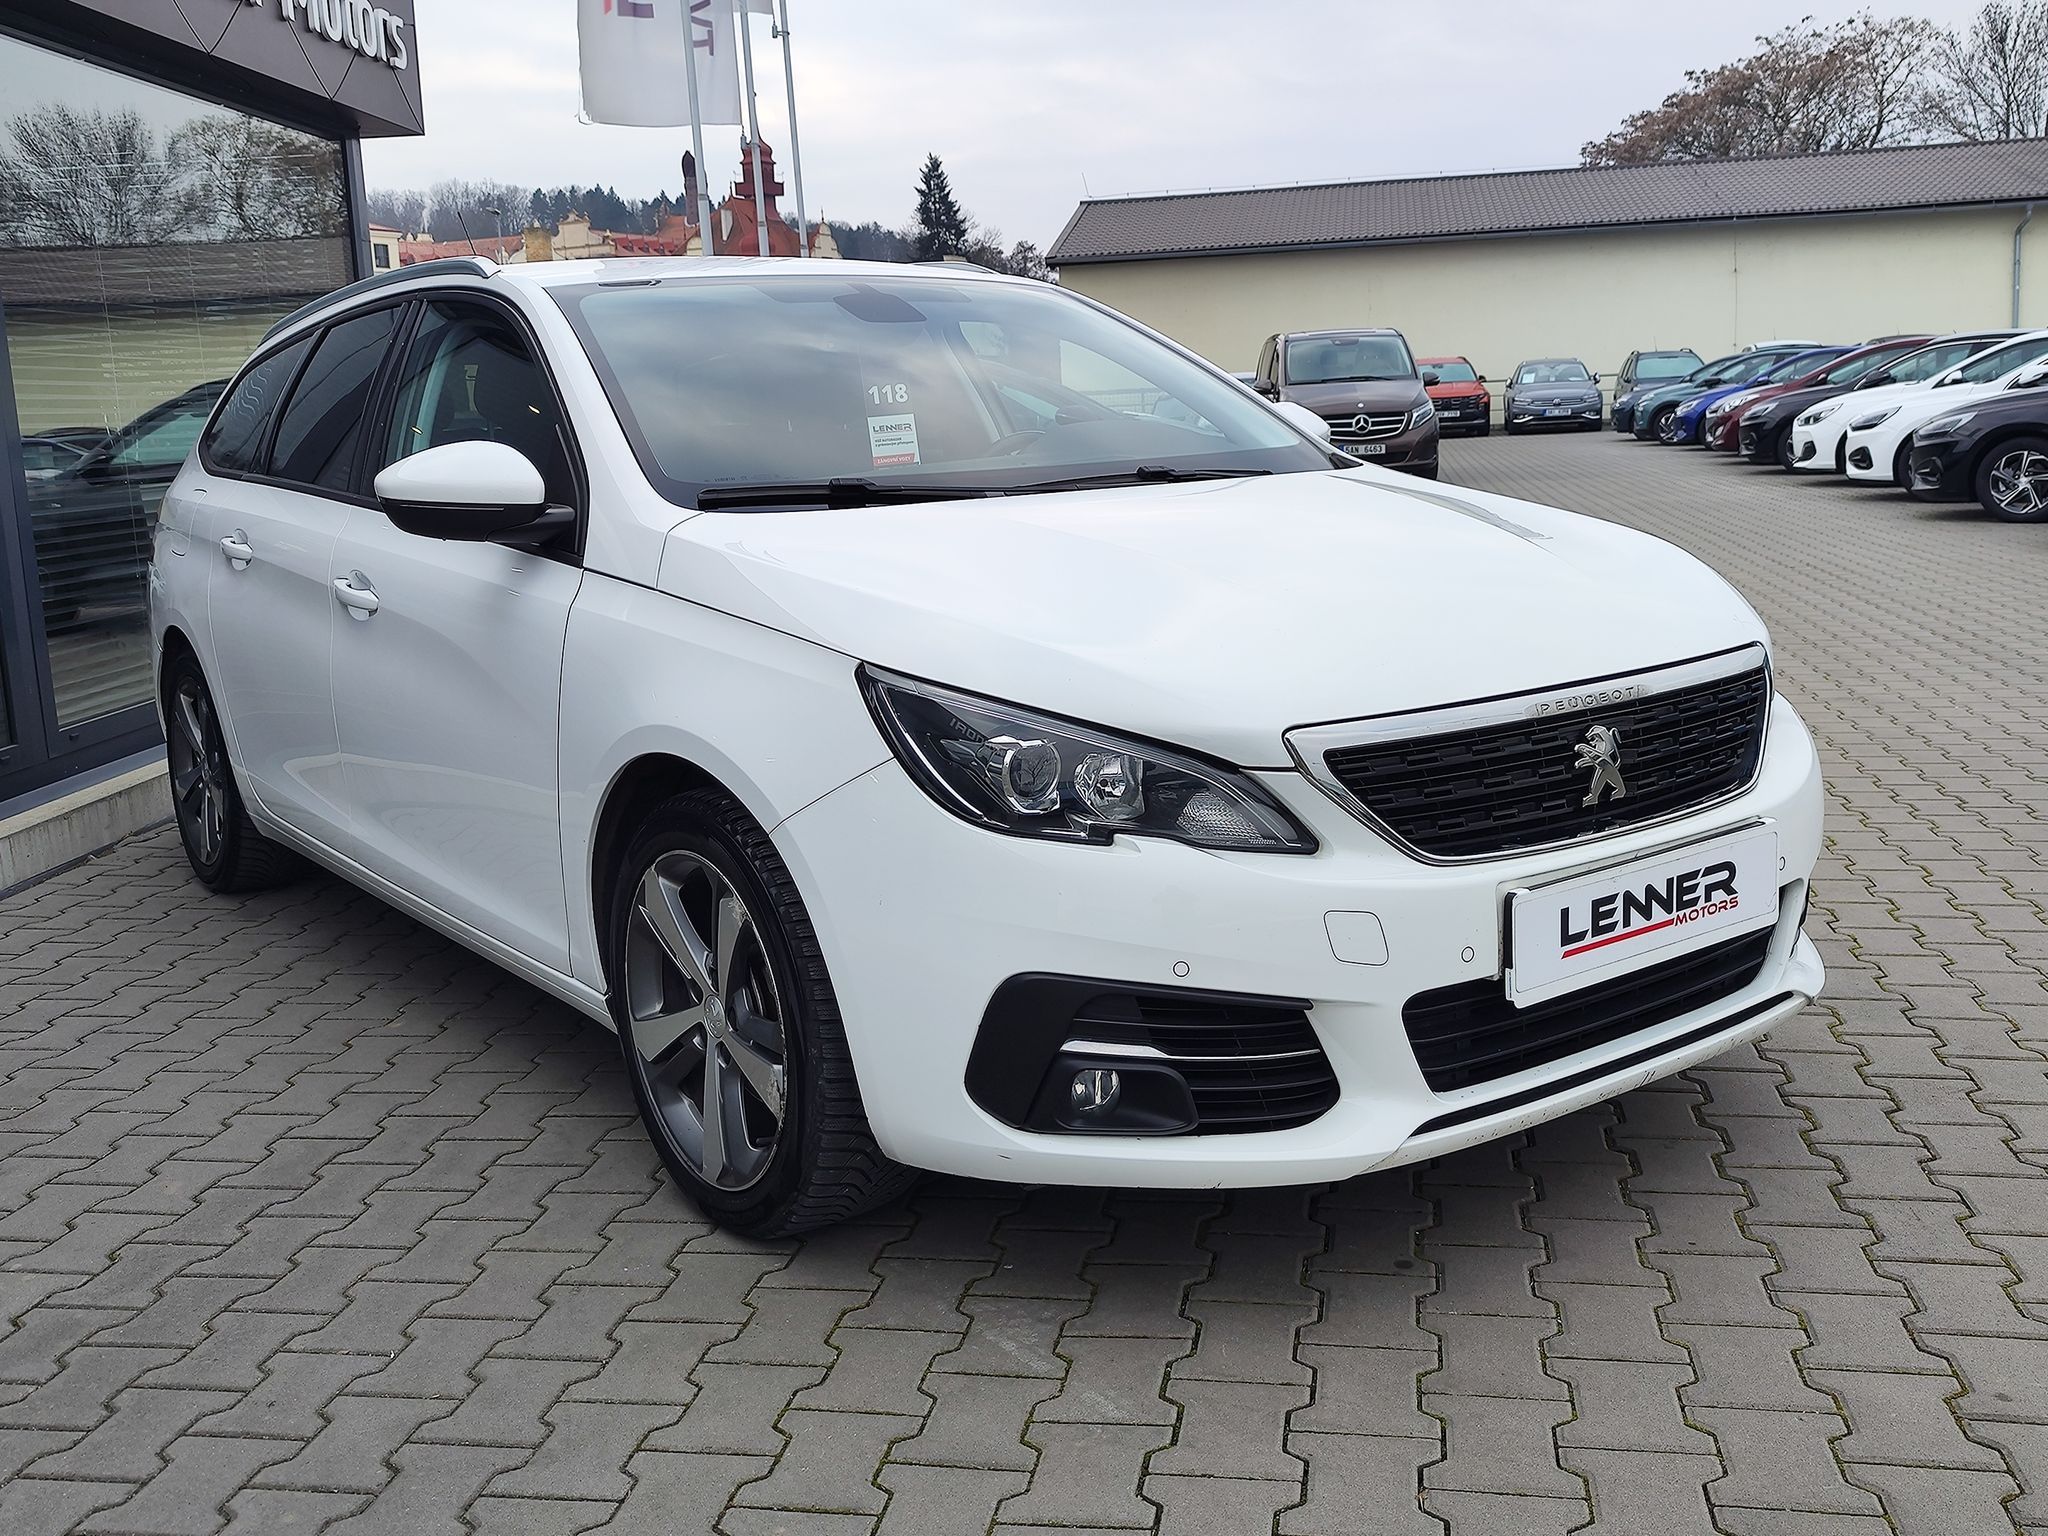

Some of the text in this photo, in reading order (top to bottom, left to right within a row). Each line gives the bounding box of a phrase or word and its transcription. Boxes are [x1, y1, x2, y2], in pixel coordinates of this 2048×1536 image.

[868, 383, 908, 404] 118
[872, 423, 913, 433] LENNER
[1364, 445, 1383, 453] 6463
[1540, 687, 1634, 715] PEUGEOT
[1561, 861, 1738, 948] LENNER
[1675, 895, 1739, 927] MOTORS
